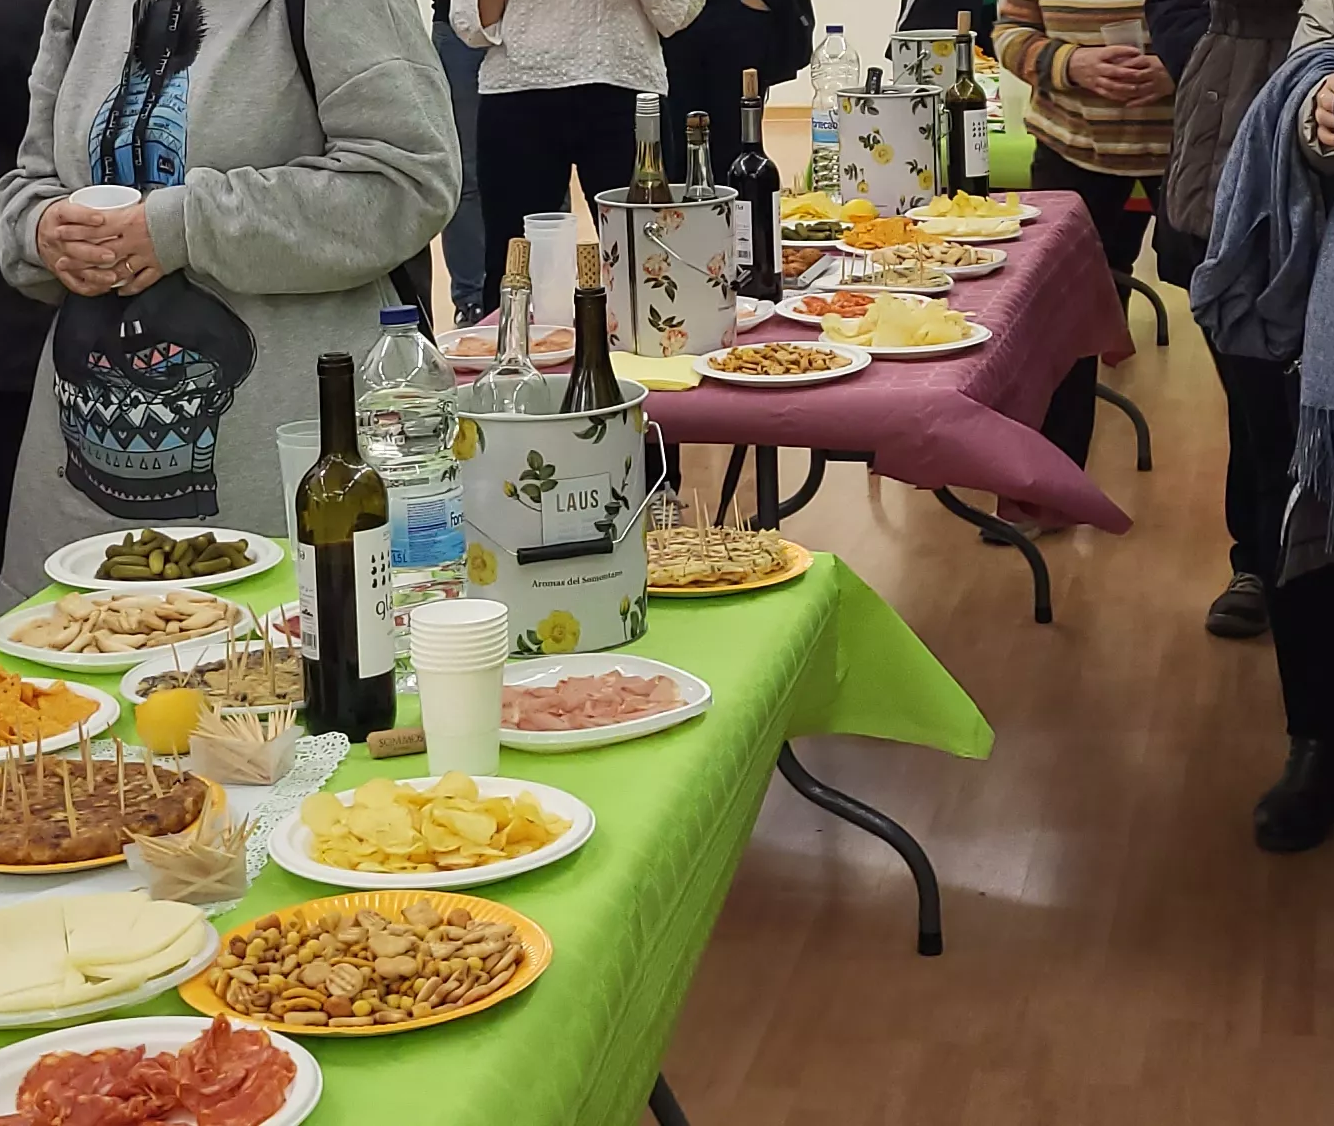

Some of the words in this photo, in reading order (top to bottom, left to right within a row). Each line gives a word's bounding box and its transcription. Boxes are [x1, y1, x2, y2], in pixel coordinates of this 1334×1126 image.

[556, 489, 599, 513] LAUS
[531, 578, 566, 588] Aromas
[567, 576, 580, 586] del
